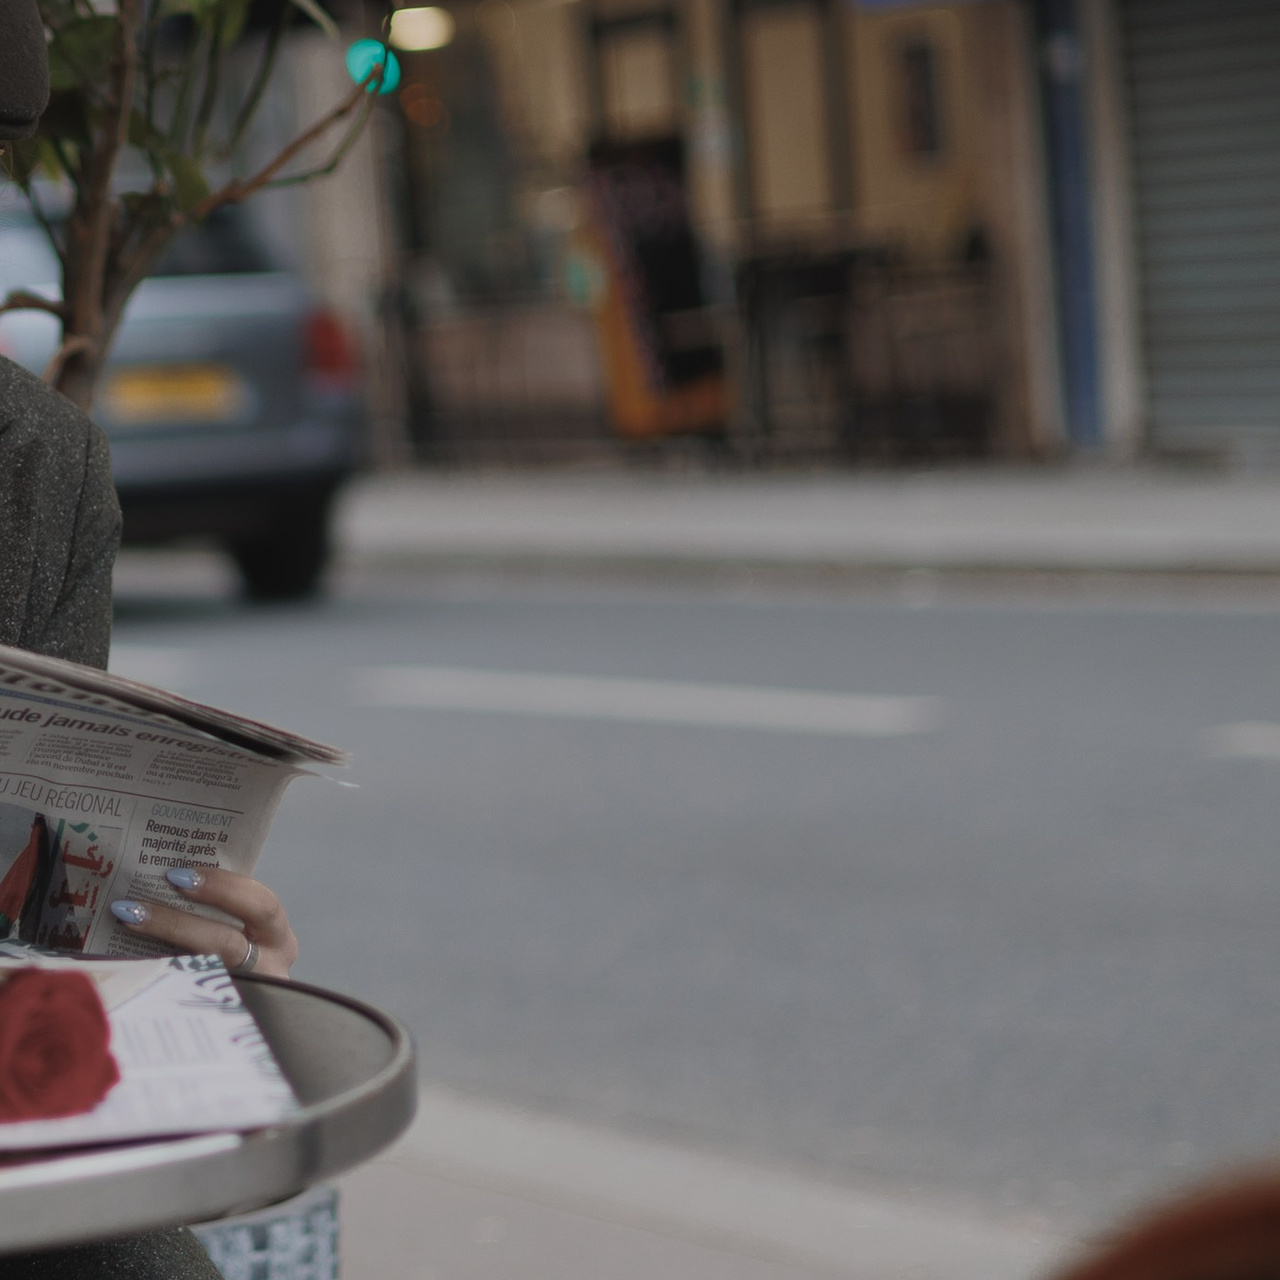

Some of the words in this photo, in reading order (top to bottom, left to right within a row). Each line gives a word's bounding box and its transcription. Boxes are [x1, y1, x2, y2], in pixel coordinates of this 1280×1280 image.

[41, 711, 132, 738] jamais
[10, 782, 41, 799] JEU
[44, 784, 121, 817] RÉGIONAL
[151, 803, 234, 828] GOUVERNEMENT
[145, 819, 189, 839] Remous
[190, 828, 215, 842] dans
[217, 830, 228, 843] la
[139, 851, 148, 865] le
[141, 837, 186, 853] majorité
[187, 844, 216, 857] après
